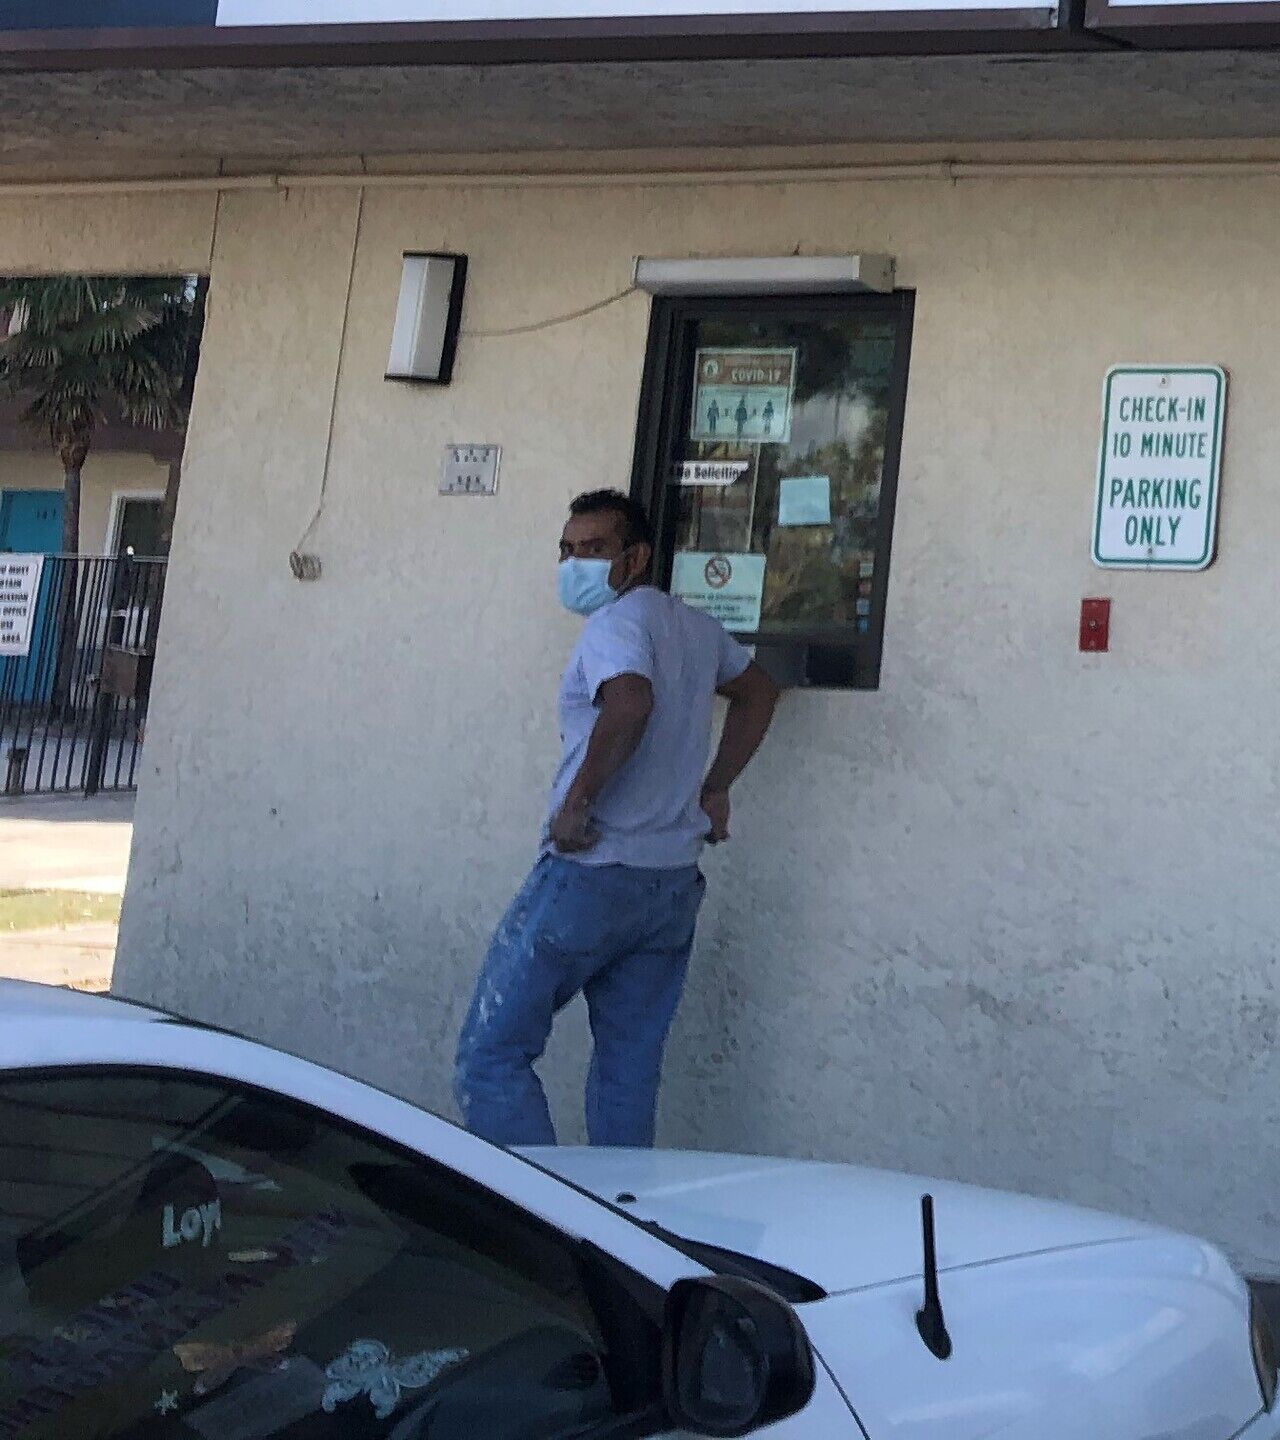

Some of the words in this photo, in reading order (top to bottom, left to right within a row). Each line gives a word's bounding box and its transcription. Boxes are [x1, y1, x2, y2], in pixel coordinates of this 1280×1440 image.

[1119, 396, 1205, 422] CHECK-IN
[1113, 432, 1130, 458] 10
[1140, 432, 1207, 458] MINUTE
[1109, 477, 1200, 509] PARKING
[1125, 514, 1181, 546] ONLY
